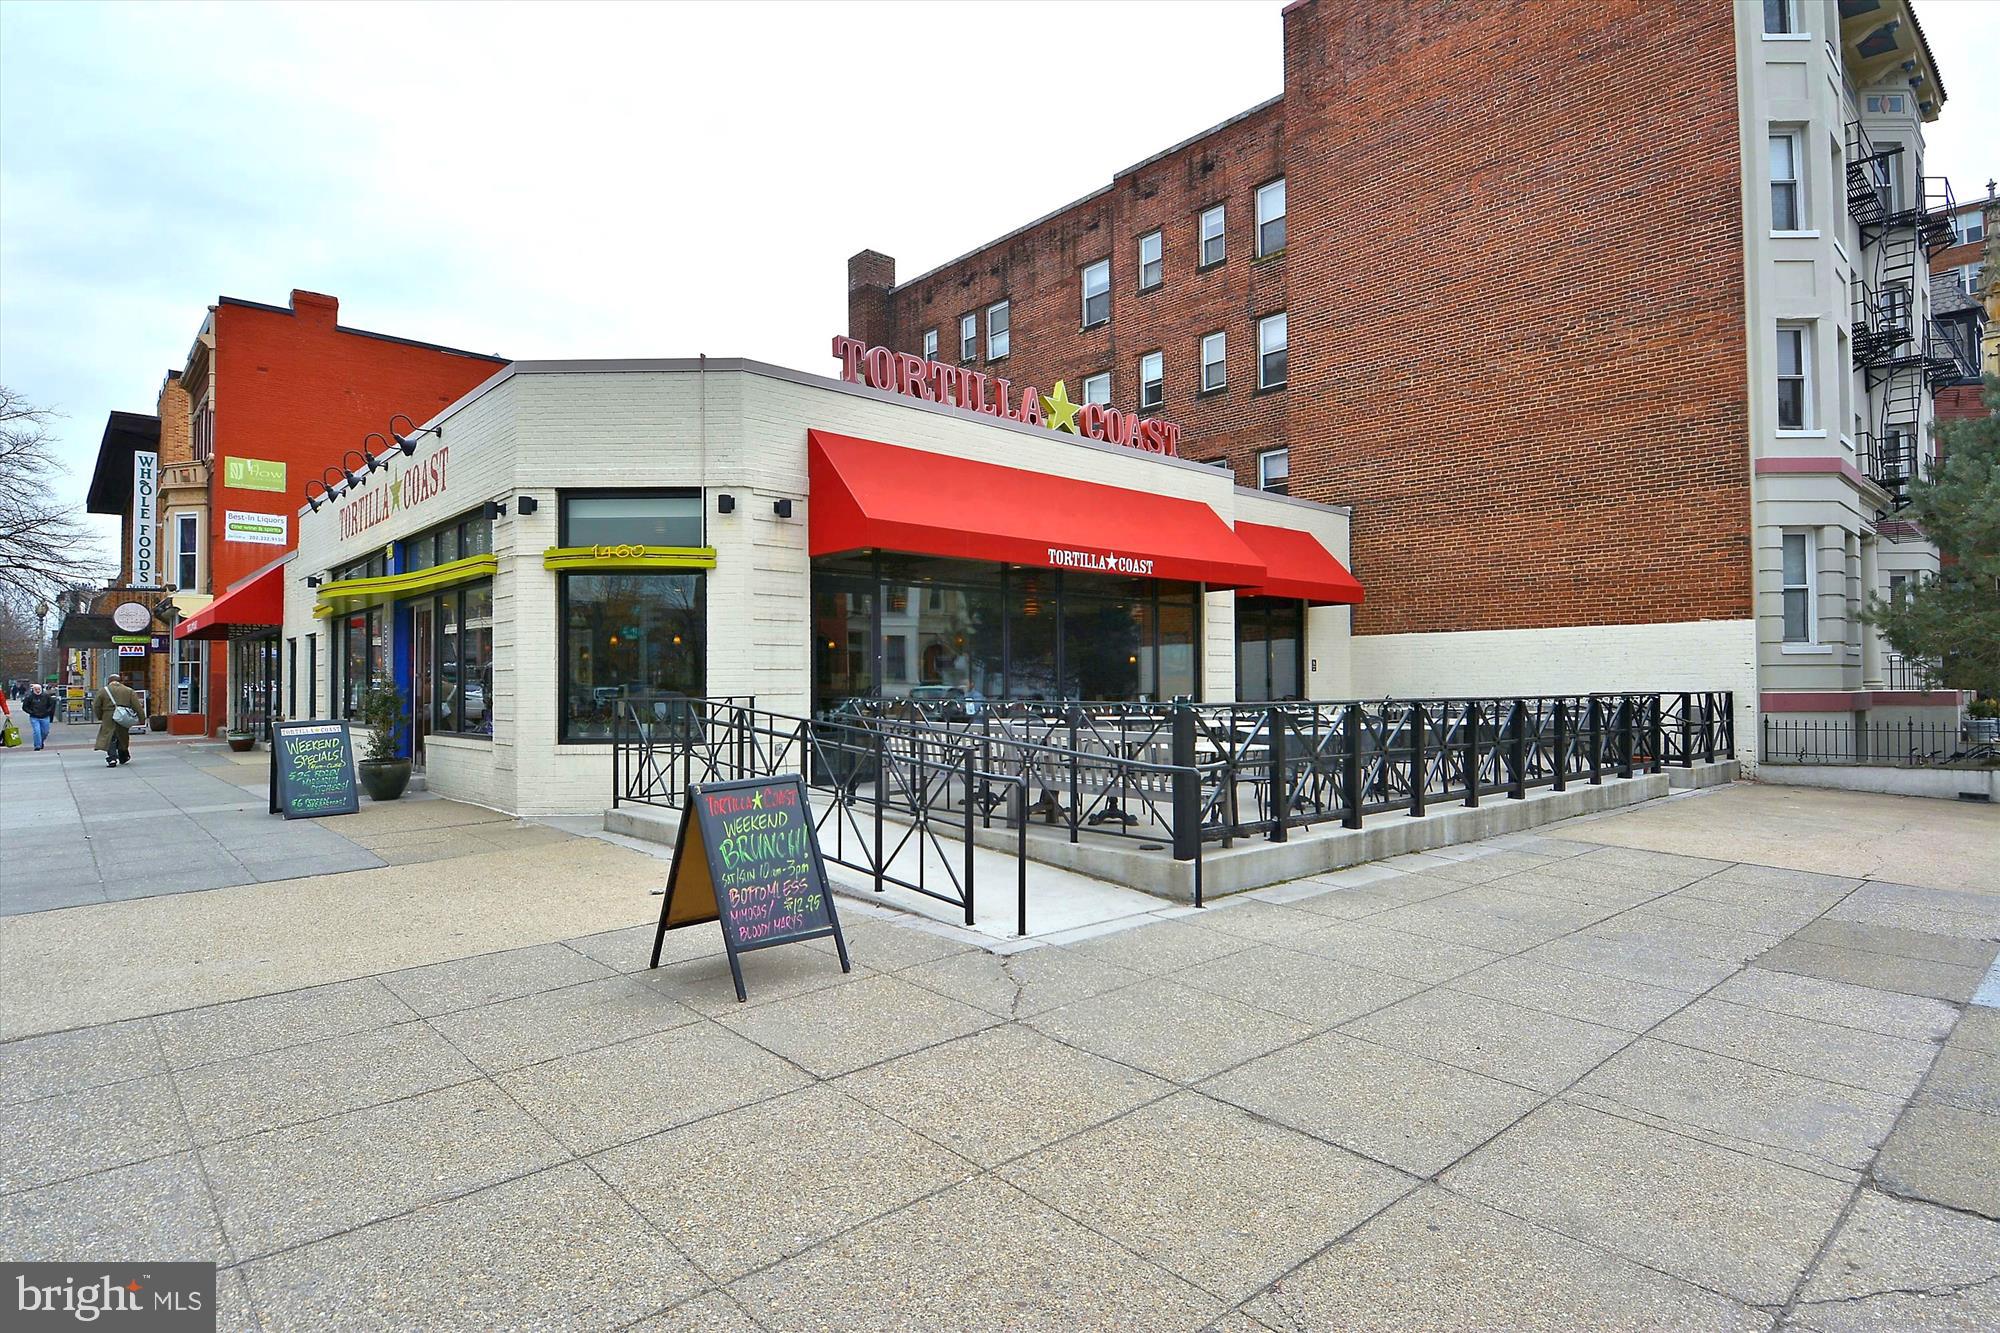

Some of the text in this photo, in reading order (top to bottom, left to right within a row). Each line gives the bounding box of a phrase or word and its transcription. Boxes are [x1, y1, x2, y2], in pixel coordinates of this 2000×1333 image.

[832, 335, 1181, 458] TORTILLA COAST
[340, 446, 449, 541] TORTILLA COAST
[138, 455, 154, 583] WHOLE FOODS
[228, 512, 285, 525] Best-In Liquors
[592, 544, 645, 559] 1460
[1047, 548, 1154, 575] TORTILLA COAST
[285, 737, 340, 755] WEEKEND
[293, 745, 345, 769] SPECIALS!
[705, 787, 798, 817] TORTILLA COAST
[723, 811, 788, 839] WEEKEND
[719, 823, 808, 870] BRUNCH!
[739, 921, 771, 942] BLOODY
